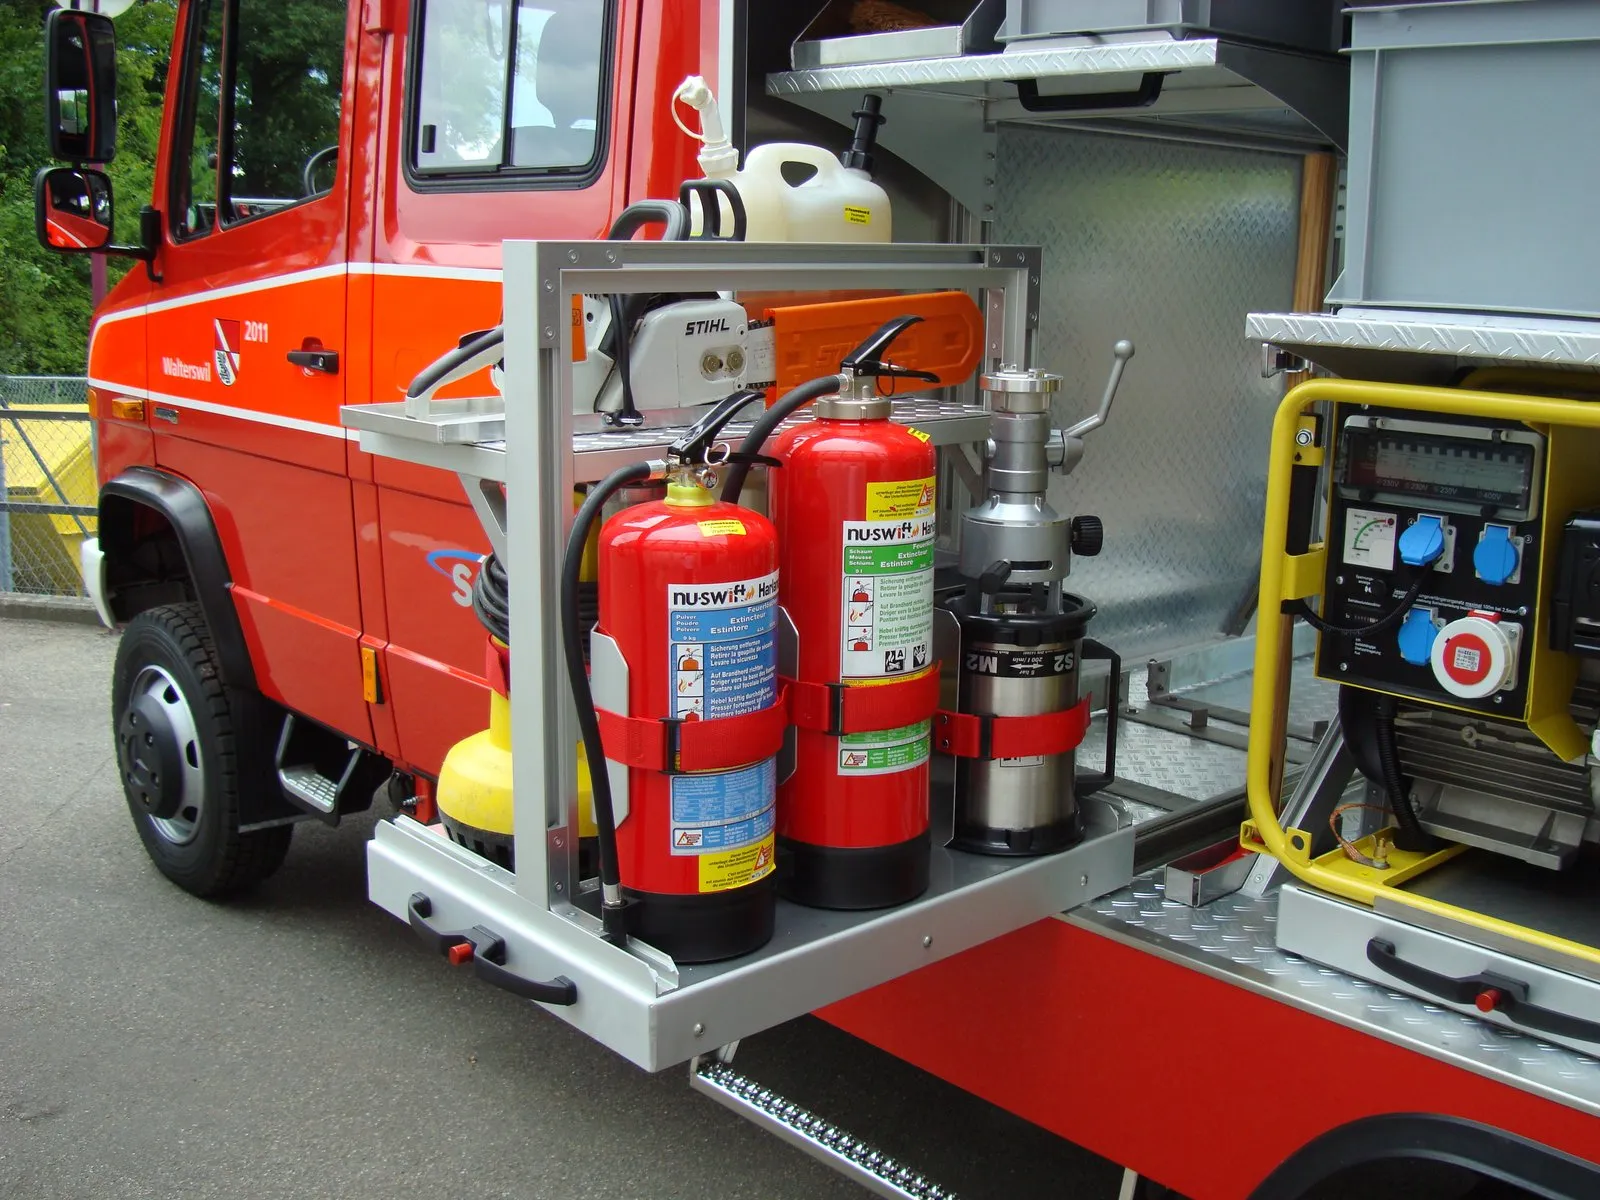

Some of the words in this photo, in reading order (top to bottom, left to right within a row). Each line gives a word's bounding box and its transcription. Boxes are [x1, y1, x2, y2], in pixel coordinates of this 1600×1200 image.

[244, 320, 268, 343] 2011
[685, 318, 730, 336] STIHL
[162, 356, 211, 382] Walterswil
[1439, 486, 1458, 495] 230V
[897, 549, 928, 559] Extincteur
[880, 559, 914, 568] Estintore
[730, 612, 766, 624] Extincteur
[710, 625, 749, 634] Estintore
[710, 644, 738, 653] Sicherung
[921, 644, 926, 653] B
[710, 652, 730, 660] Retirer
[897, 649, 903, 658] A
[737, 655, 758, 664] sicurezza
[966, 653, 998, 674] M2
[1053, 652, 1074, 672] S2
[711, 671, 721, 679] Auf
[721, 668, 748, 678] Brandherd
[710, 679, 731, 687] Diriger
[710, 697, 727, 705] Hebel
[727, 693, 745, 703] kräftig
